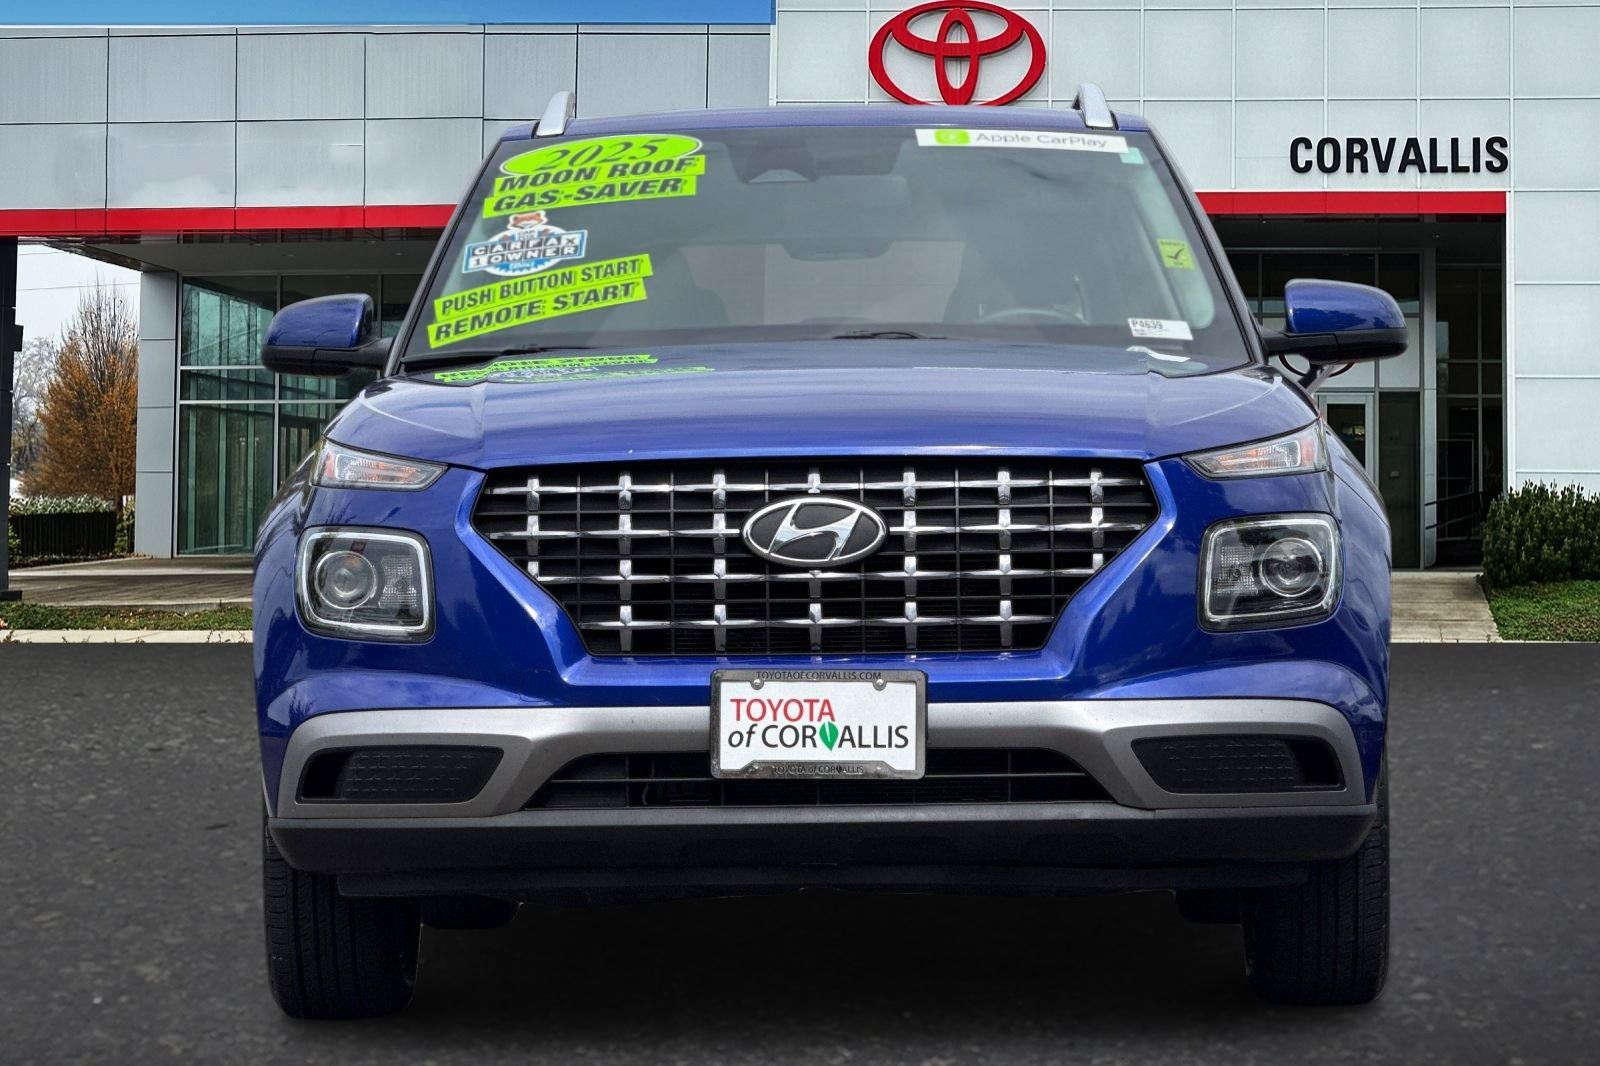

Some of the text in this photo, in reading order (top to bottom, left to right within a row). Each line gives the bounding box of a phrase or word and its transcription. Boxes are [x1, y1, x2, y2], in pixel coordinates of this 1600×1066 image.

[976, 131, 1108, 149] Apple CarPlay
[534, 138, 668, 172] 2025
[1290, 136, 1509, 174] CORVALLIS
[499, 157, 696, 192] MOON ROOF
[493, 177, 686, 212] GAS-SAVER
[473, 236, 577, 255] CARFAX
[490, 246, 577, 263] OWNER
[441, 258, 641, 316] PUSH BUTTON START
[434, 281, 637, 342] REMOTE START
[756, 671, 882, 681] TOYOTAOFCORVALLIS.COM
[730, 698, 836, 722] TOYOTA
[727, 723, 758, 748] of
